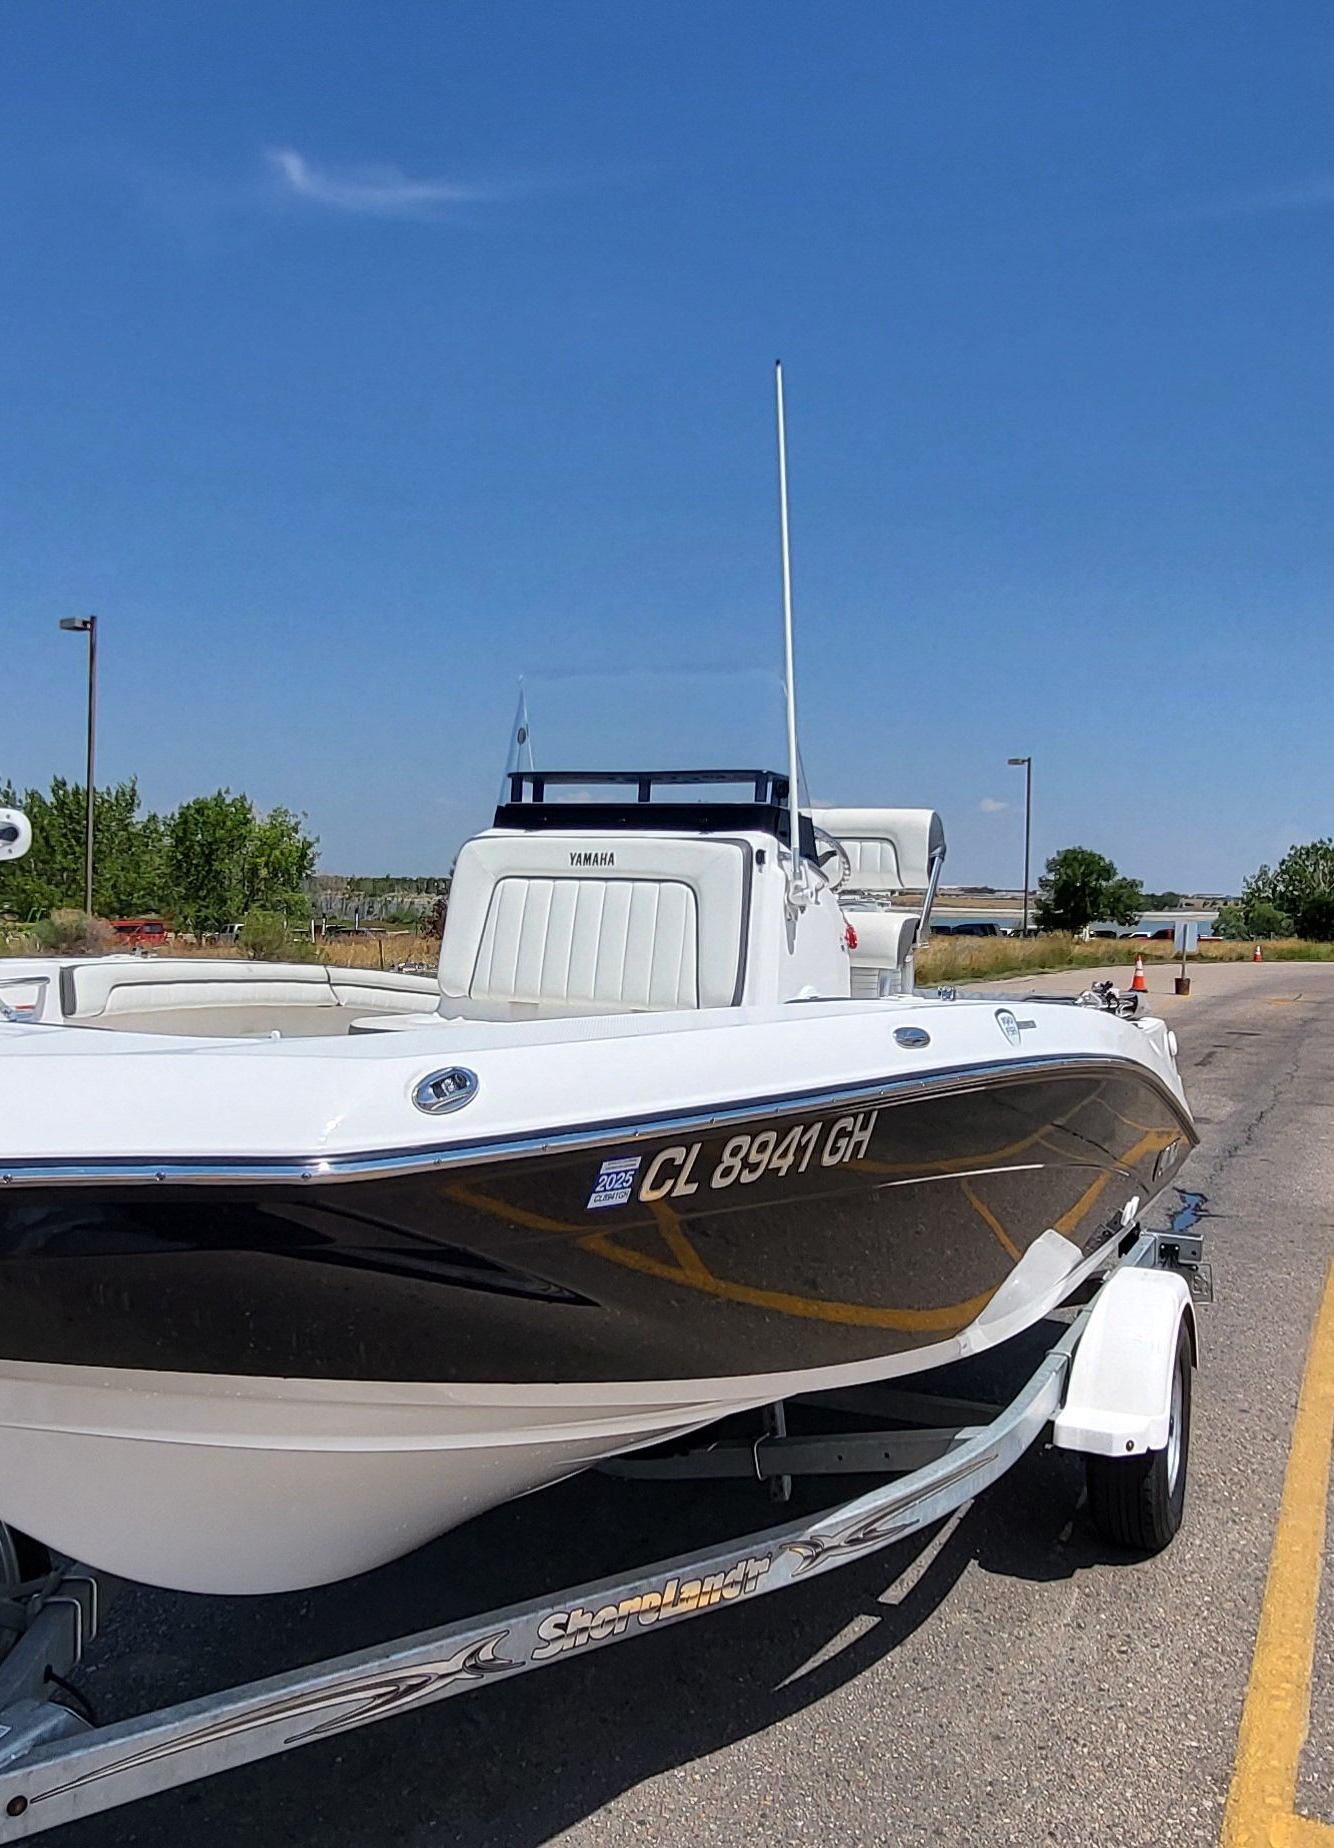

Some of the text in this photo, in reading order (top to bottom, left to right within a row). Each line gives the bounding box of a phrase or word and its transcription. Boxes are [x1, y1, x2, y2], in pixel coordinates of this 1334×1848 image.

[569, 852, 615, 867] YAMAHA
[638, 1110, 878, 1202] CL 8941 GH
[595, 1170, 635, 1192] 2025
